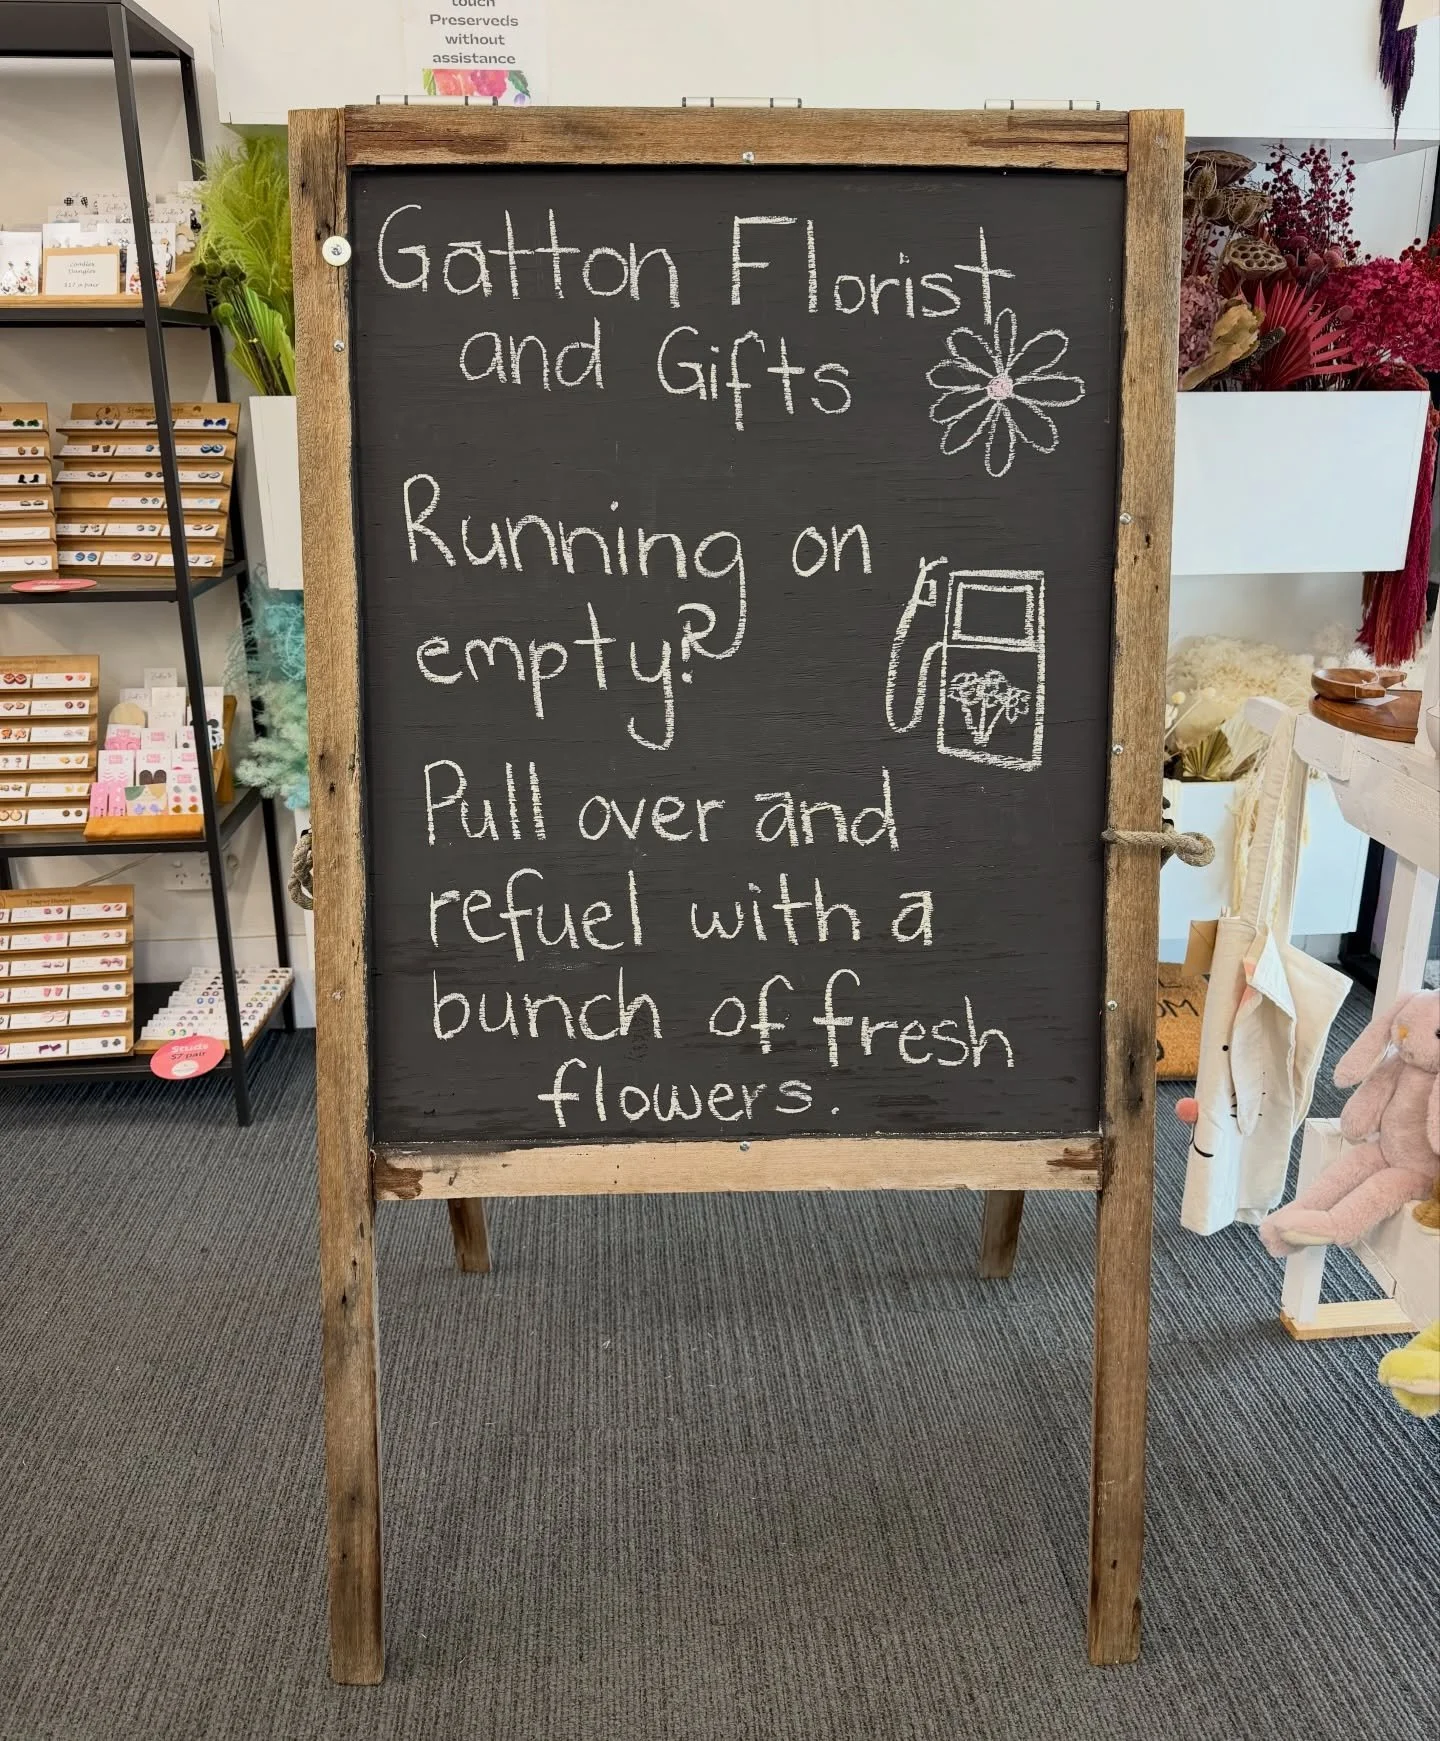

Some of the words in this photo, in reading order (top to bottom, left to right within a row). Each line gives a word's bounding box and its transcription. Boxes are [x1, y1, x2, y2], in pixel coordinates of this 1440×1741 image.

[429, 14, 519, 27] Preserveds
[432, 52, 516, 64] assistance
[445, 33, 505, 46] without
[378, 204, 680, 309] Gatton
[731, 215, 1016, 326] Florist
[459, 317, 605, 391] and
[657, 325, 852, 431] Gifts
[403, 473, 747, 662] Running
[791, 523, 873, 577] on
[416, 602, 718, 751] empty?
[423, 759, 547, 847] Pull
[578, 795, 726, 843] over
[754, 766, 900, 852] and
[429, 867, 643, 963] refuel
[691, 872, 862, 946] with
[890, 890, 934, 946] a
[432, 967, 663, 1041] bunch
[709, 974, 787, 1055] of
[813, 968, 1015, 1068] fresh
[538, 1057, 840, 1128] flowers.
